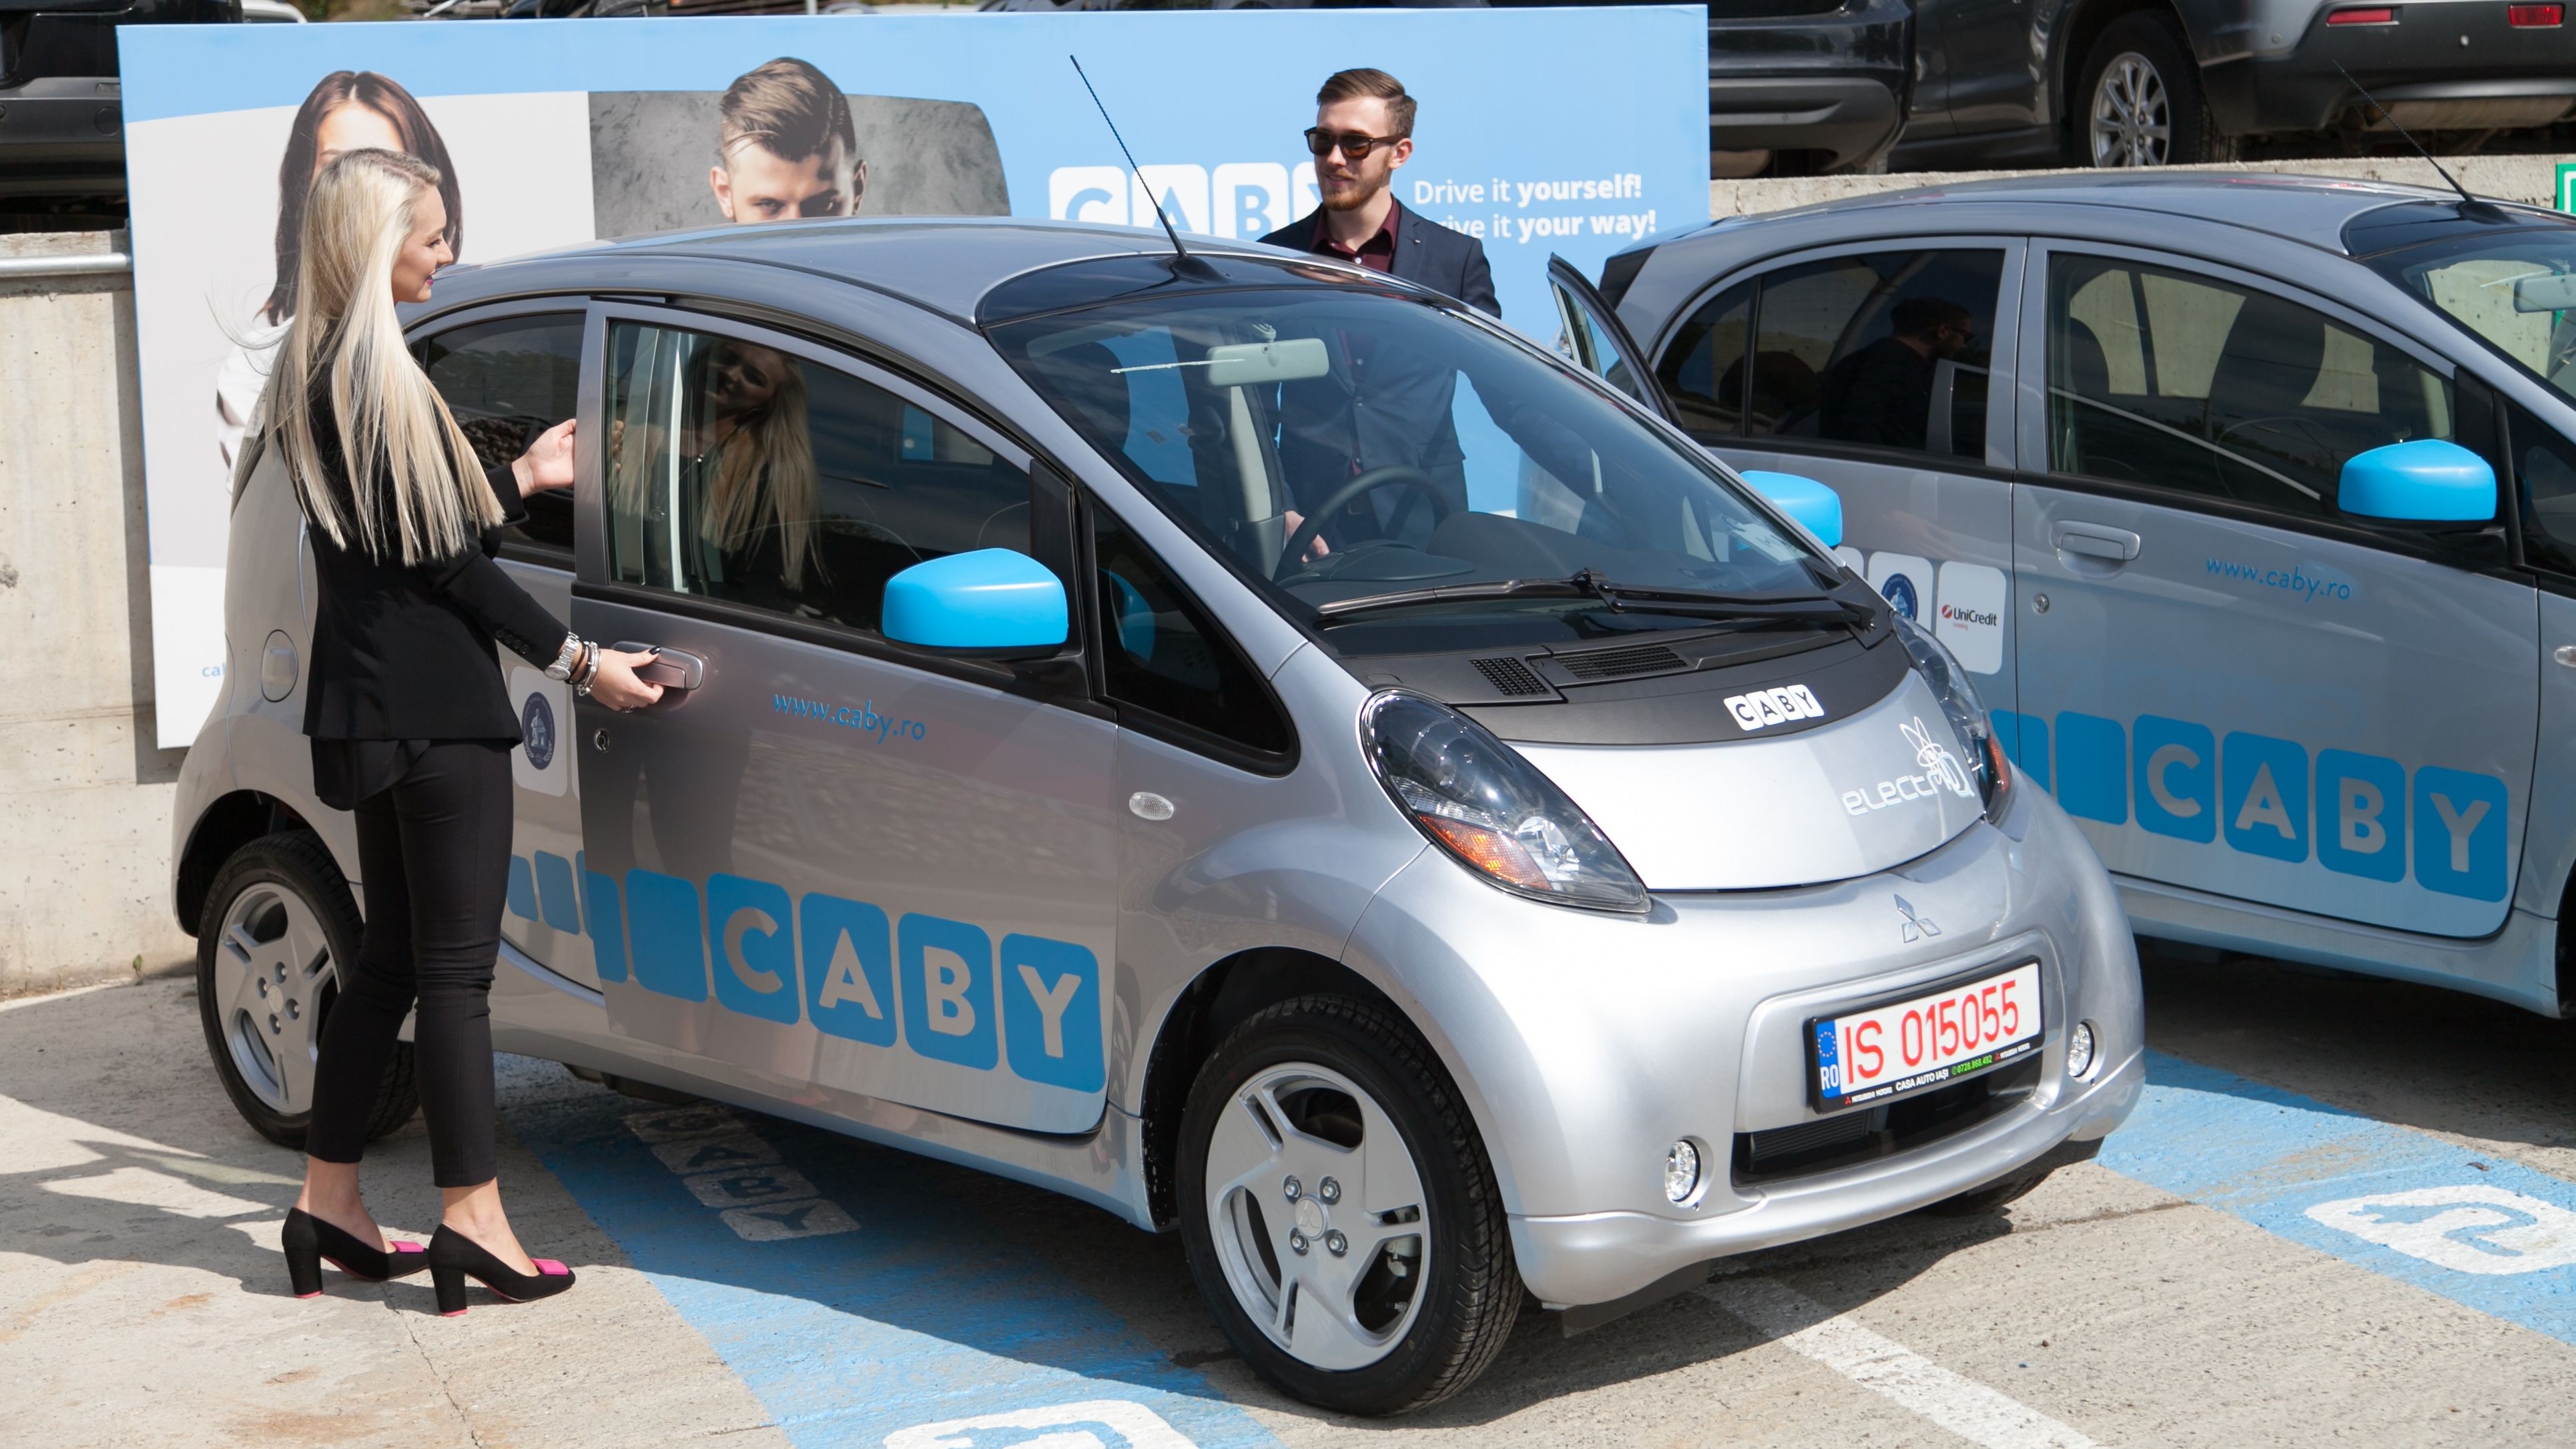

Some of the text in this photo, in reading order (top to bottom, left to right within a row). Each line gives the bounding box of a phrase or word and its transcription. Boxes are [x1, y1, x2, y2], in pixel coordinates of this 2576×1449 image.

[1414, 173, 1642, 208] Drive it yourself!
[1065, 183, 1324, 242] CAB
[1425, 209, 1656, 244] ive it your way!
[2207, 558, 2352, 603] www.caby.ro
[1953, 607, 1997, 626] UniCredit
[773, 693, 927, 746] www.caby.ro
[1733, 689, 1819, 723] CABY
[2145, 741, 2494, 875] CABY
[721, 903, 1084, 1061] CABY
[1844, 979, 2020, 1085] IS 015055
[1821, 1064, 1839, 1091] RO
[1896, 1078, 1915, 1091] CASA
[1916, 1073, 1935, 1086] AUTO
